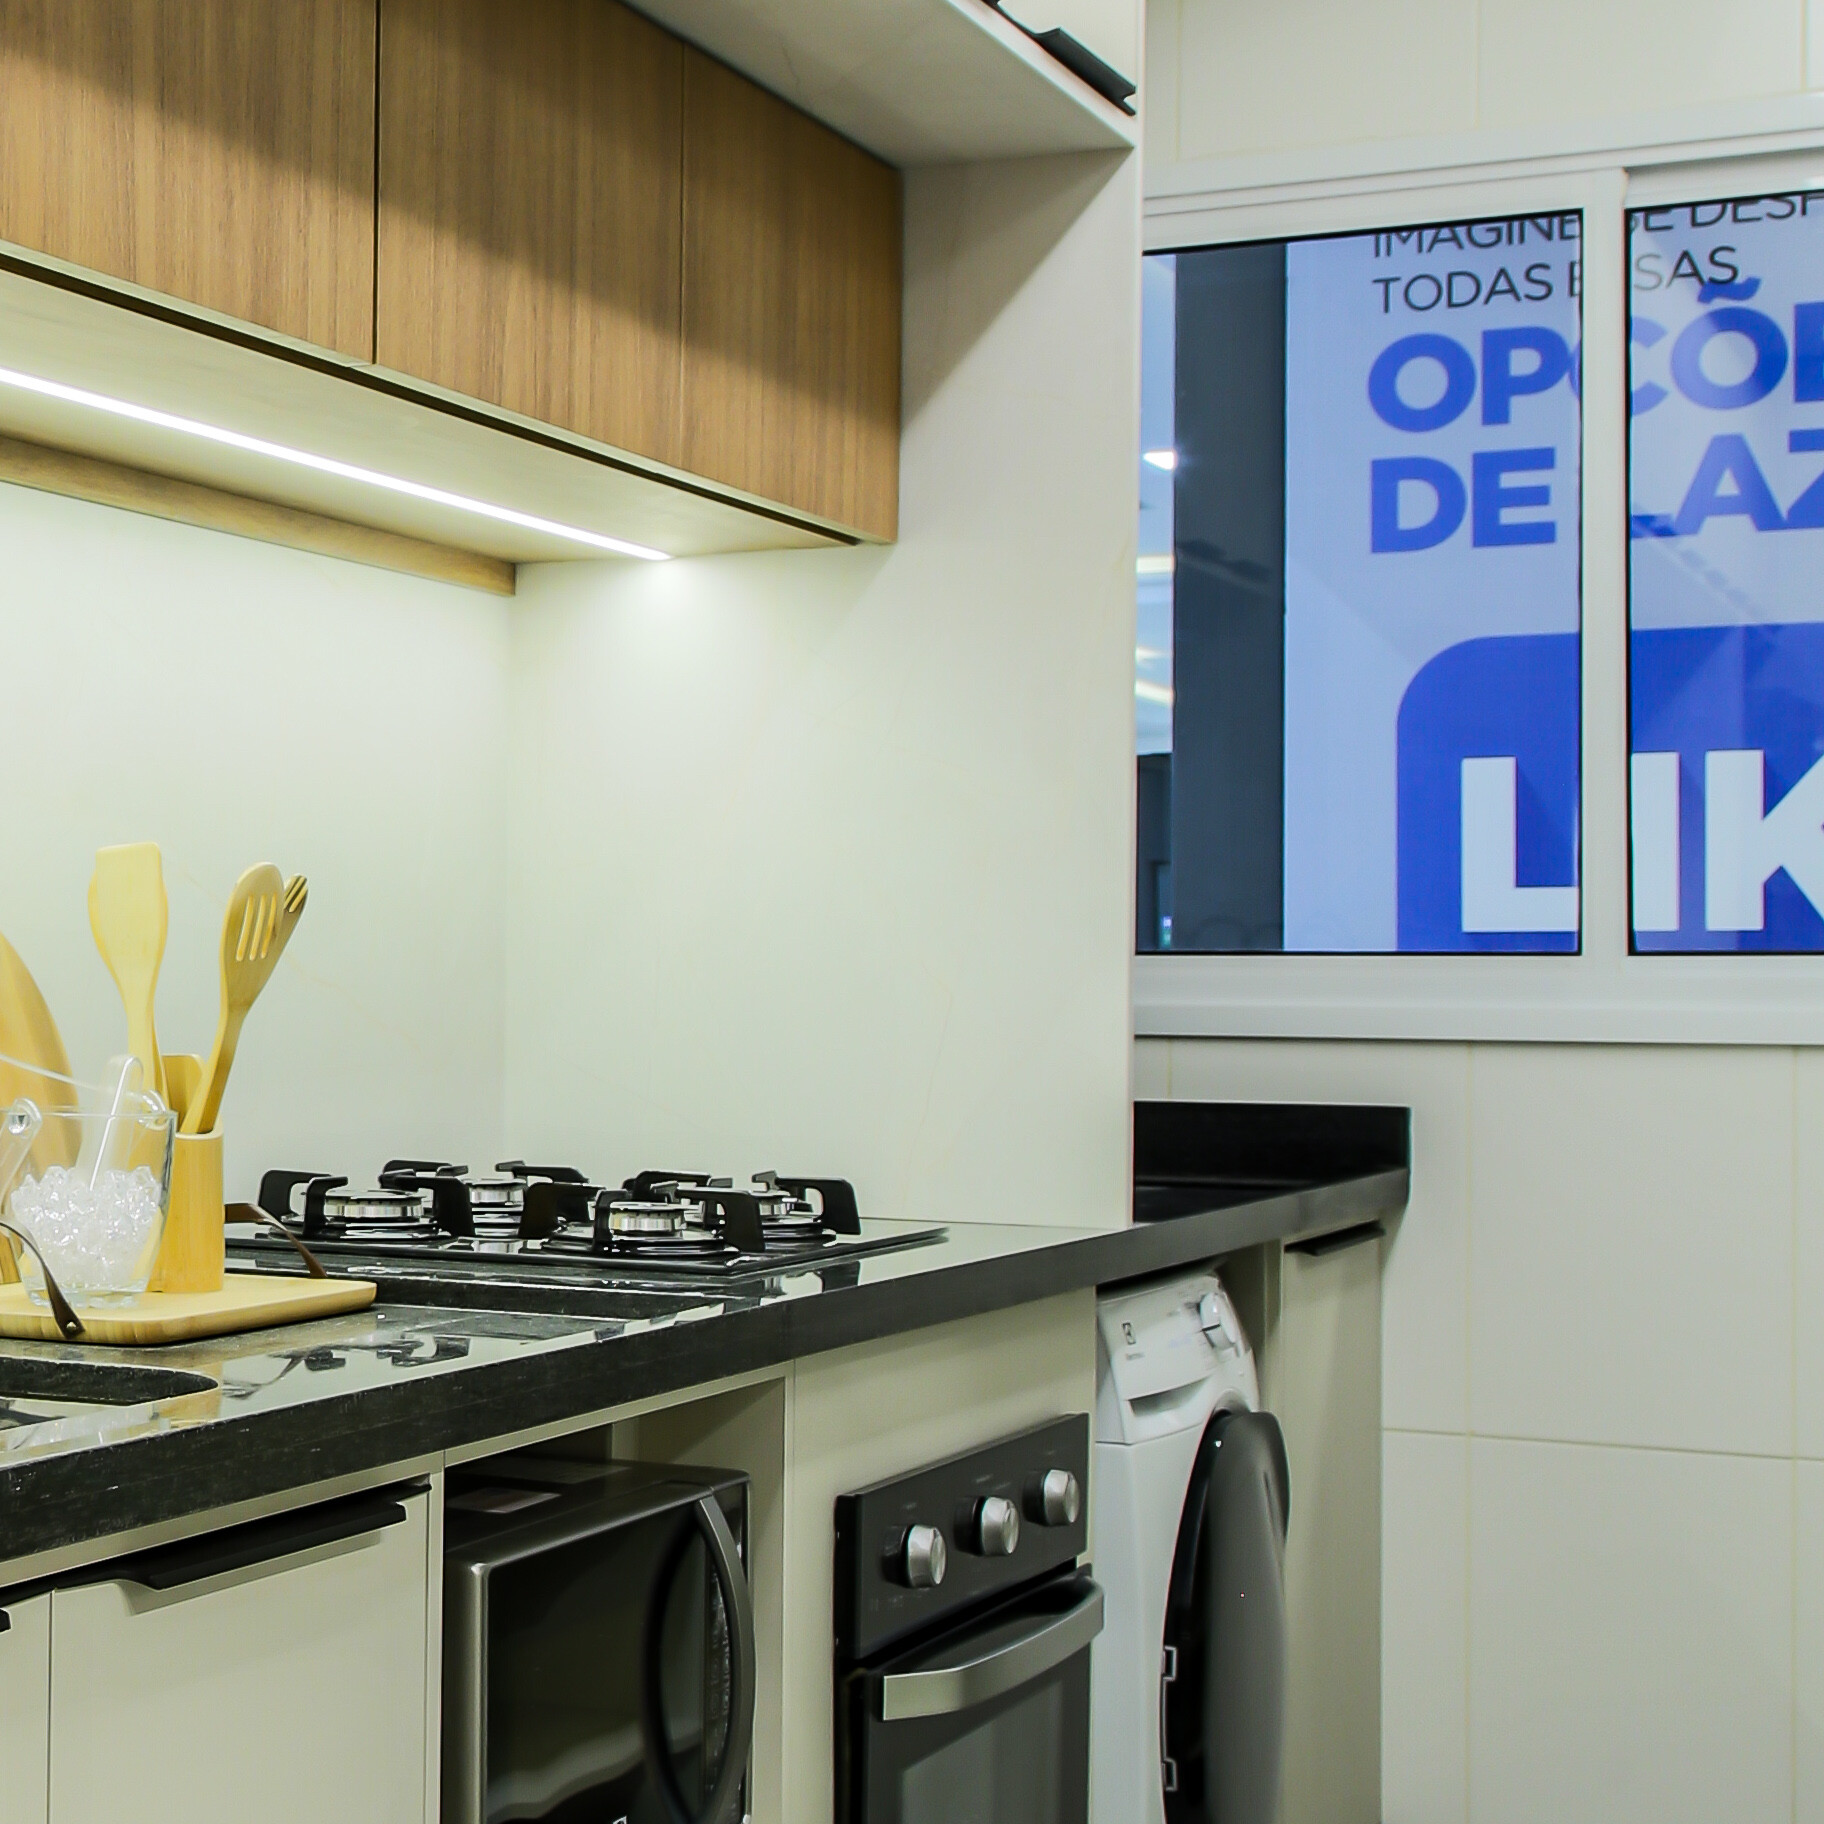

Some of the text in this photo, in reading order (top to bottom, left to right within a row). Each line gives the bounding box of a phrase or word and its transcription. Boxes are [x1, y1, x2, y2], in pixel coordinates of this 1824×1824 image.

[1372, 263, 1554, 314] TODAS
[1370, 447, 1557, 554] DE
[1461, 748, 1824, 933] LIK
